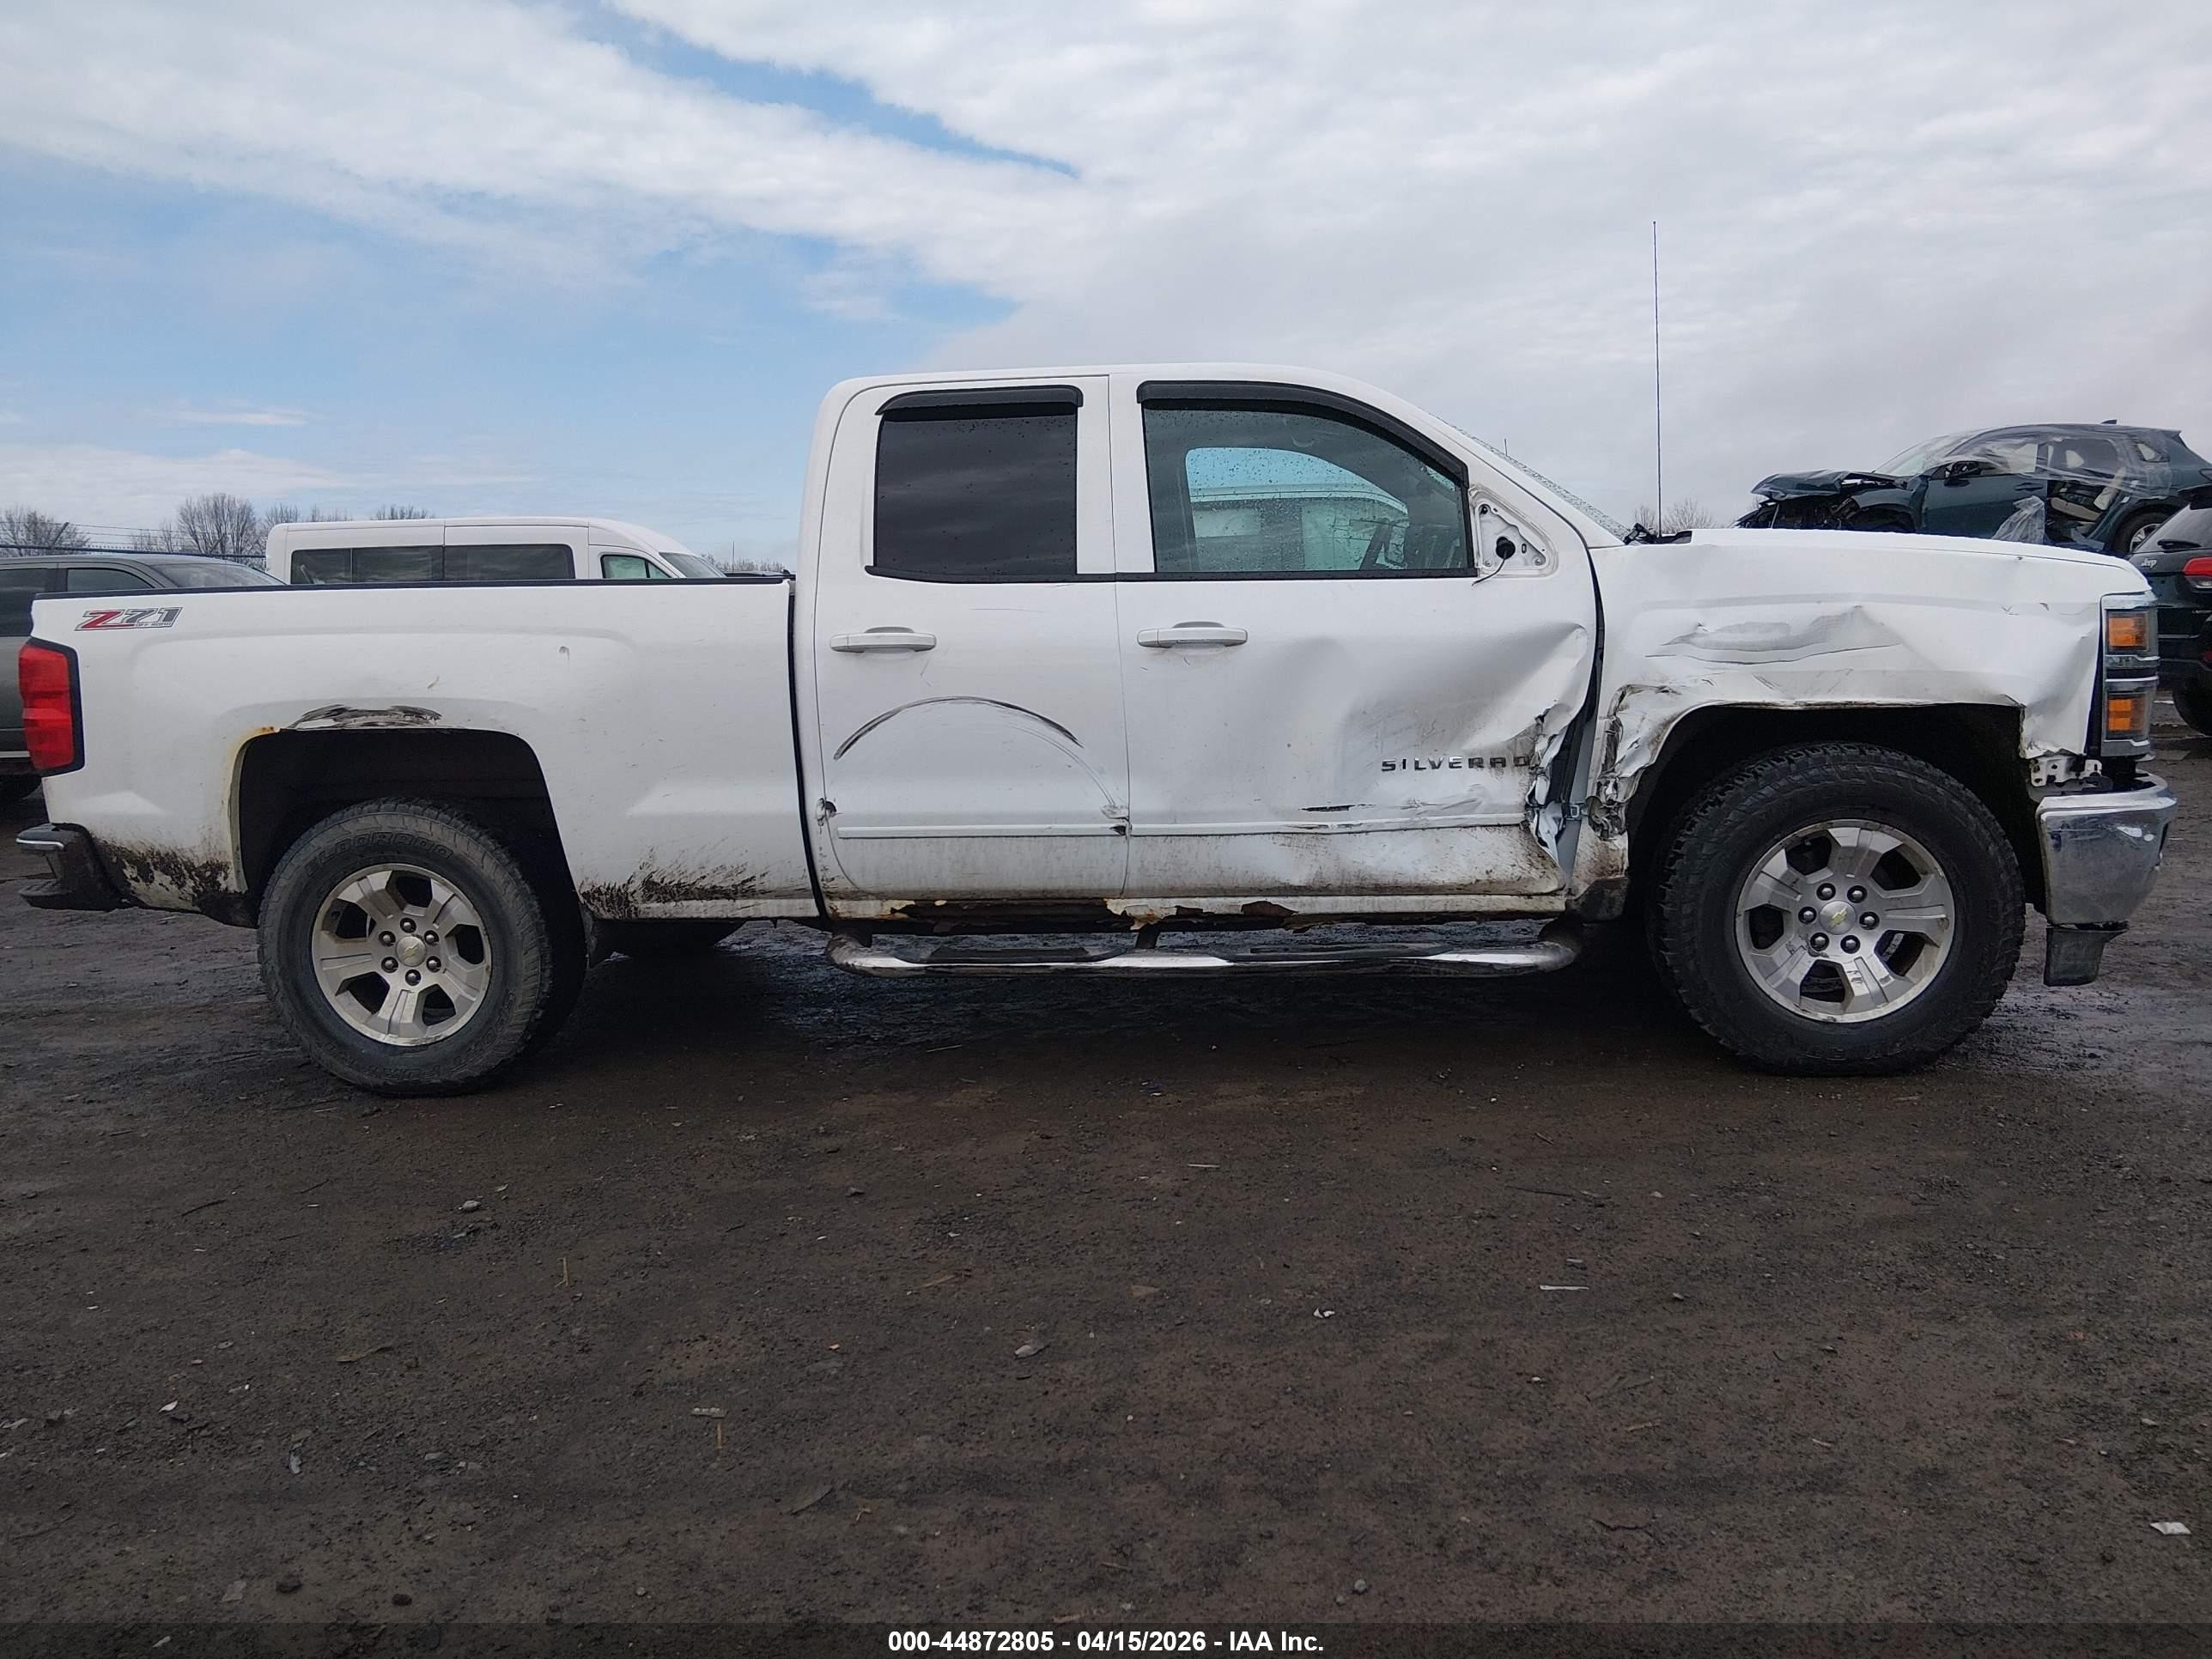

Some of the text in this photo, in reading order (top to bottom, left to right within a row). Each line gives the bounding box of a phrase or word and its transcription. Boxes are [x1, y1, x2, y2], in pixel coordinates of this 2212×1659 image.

[2141, 557, 2158, 568] Jeep
[75, 606, 184, 632] Z71
[1381, 755, 1531, 772] SILVERAD
[304, 831, 454, 876] ELDORADO
